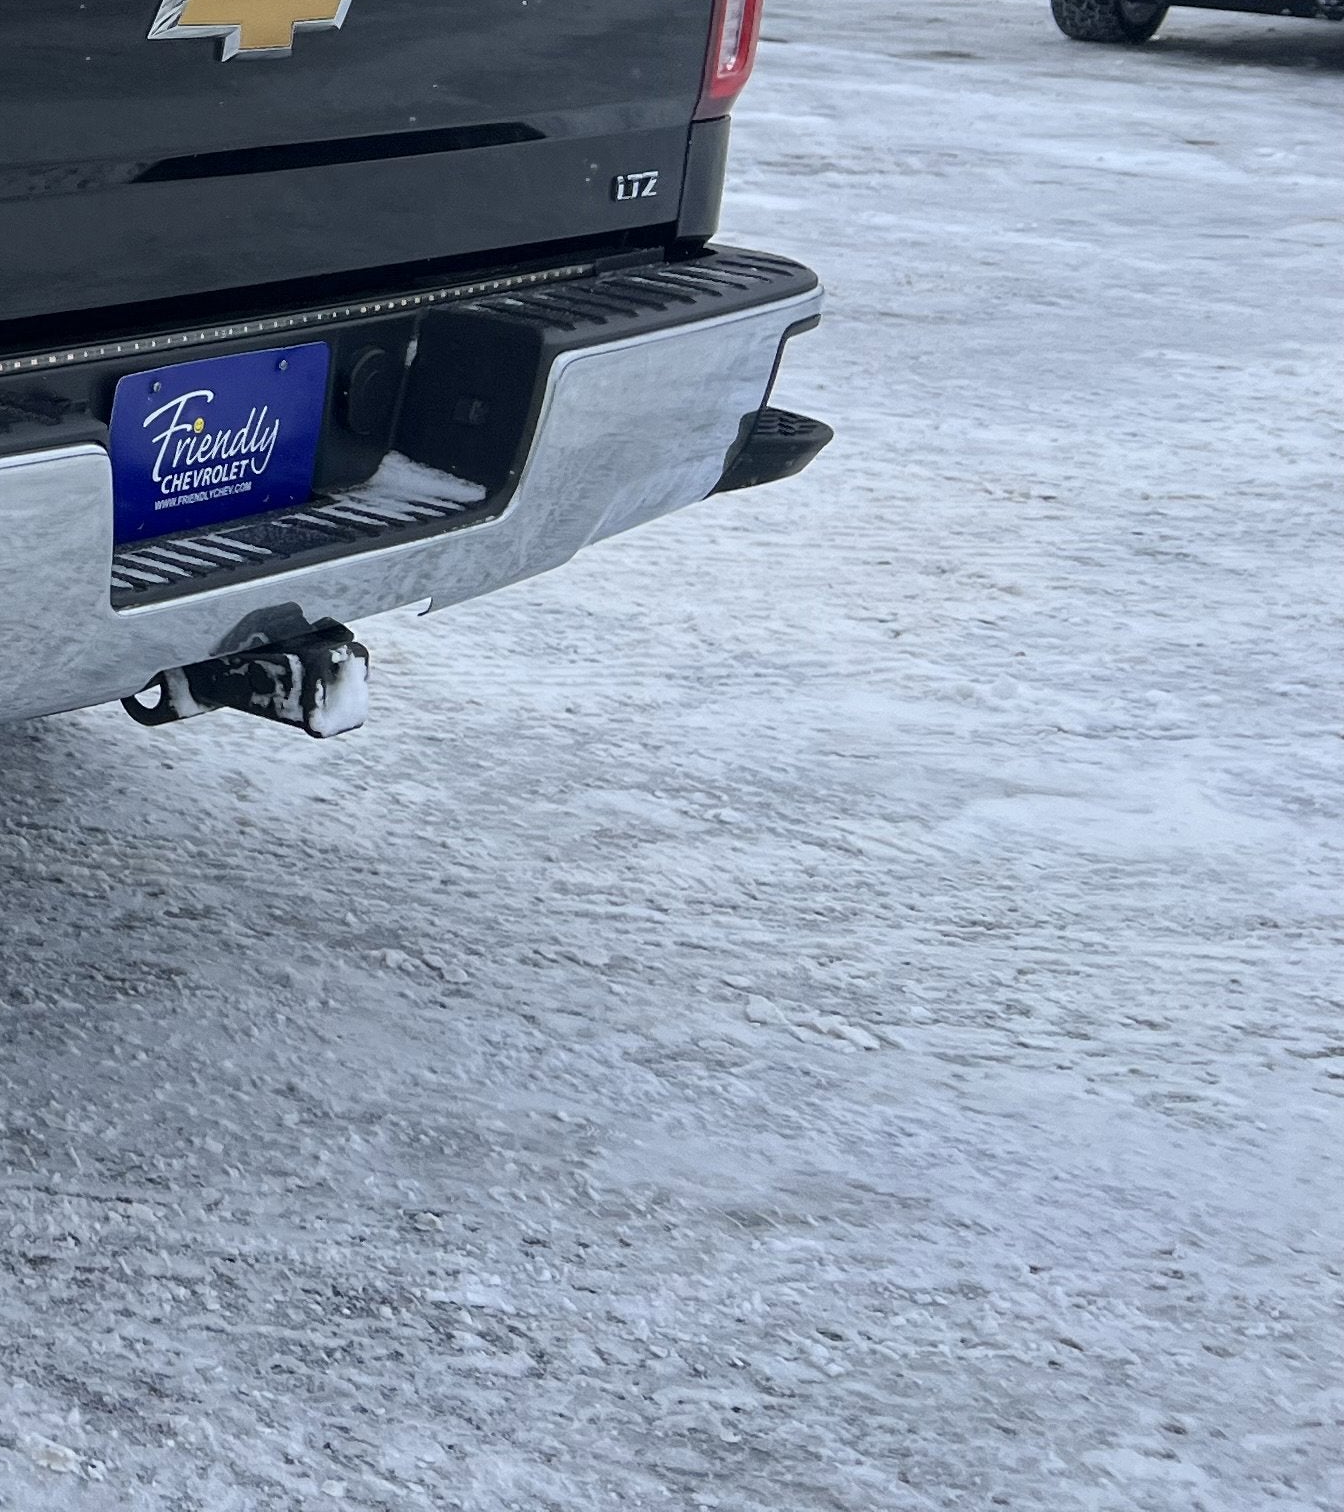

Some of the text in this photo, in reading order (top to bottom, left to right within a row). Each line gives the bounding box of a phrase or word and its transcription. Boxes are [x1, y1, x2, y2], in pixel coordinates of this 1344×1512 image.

[617, 170, 659, 200] LTZ
[143, 389, 280, 483] Friendly
[161, 459, 250, 495] CHEVROLET
